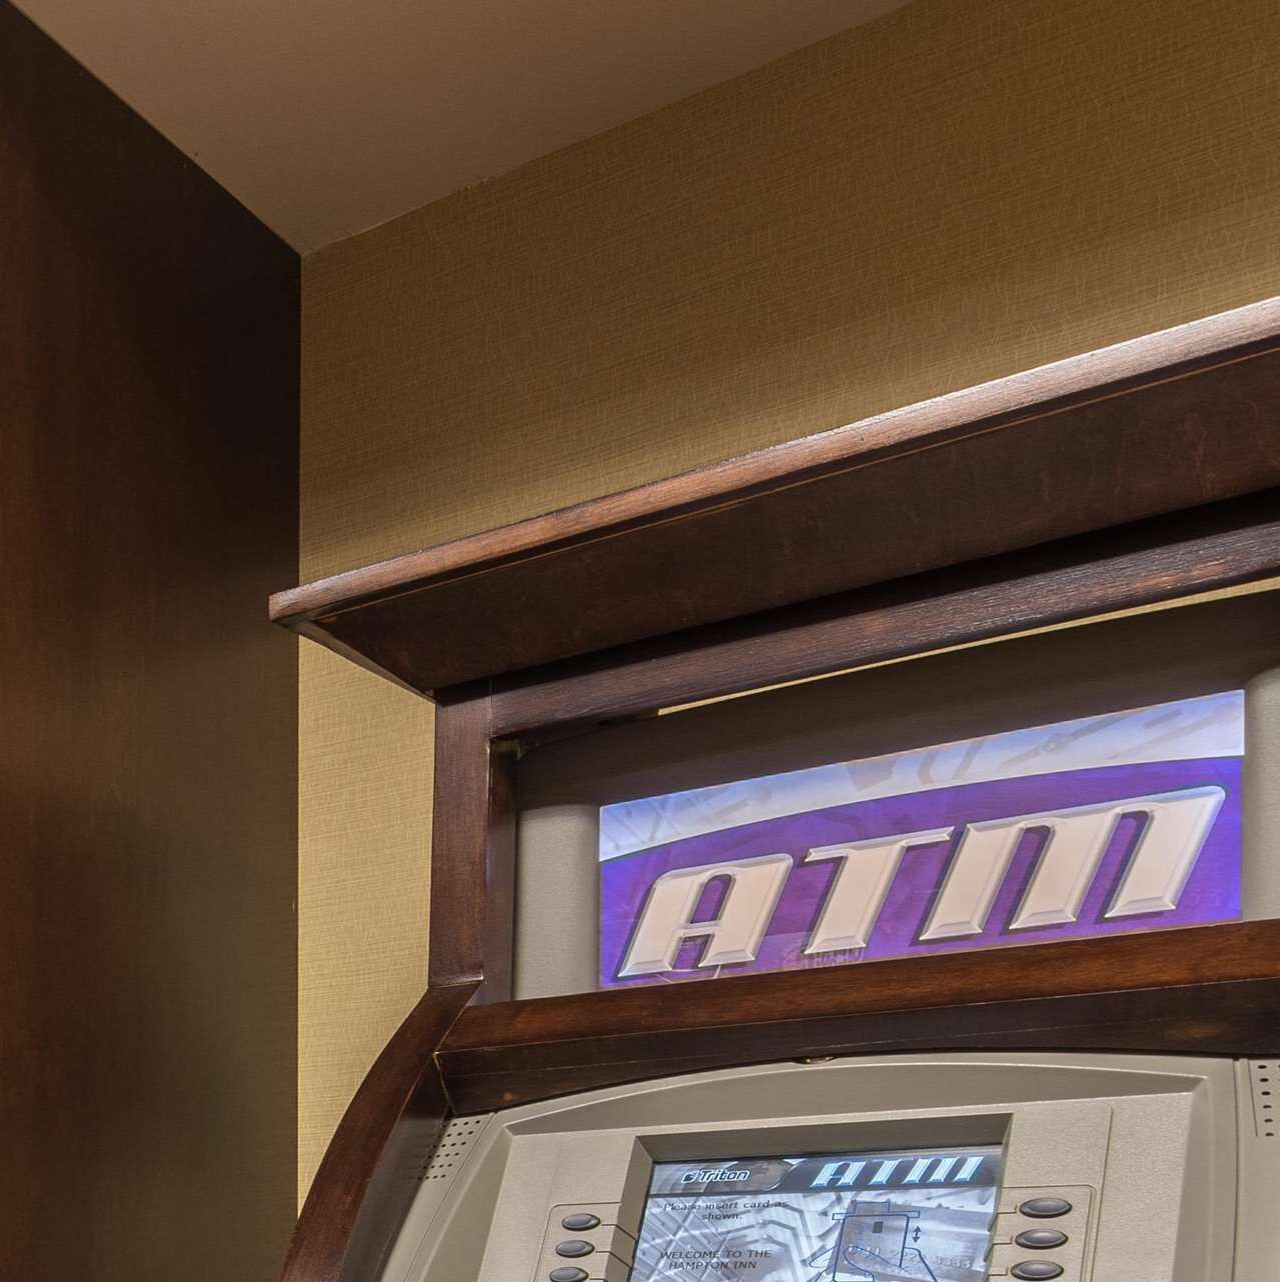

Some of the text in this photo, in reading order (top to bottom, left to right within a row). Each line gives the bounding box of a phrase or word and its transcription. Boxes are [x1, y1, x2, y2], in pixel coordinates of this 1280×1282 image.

[617, 784, 1226, 980] ATM
[698, 1168, 750, 1183] Triton
[810, 1155, 985, 1189] ATM
[664, 1202, 701, 1211] Please
[705, 1201, 739, 1210] insert
[743, 1200, 770, 1209] card
[661, 1250, 772, 1260] WELCOME TO THE
[669, 1261, 757, 1270] HAMPTON INN
